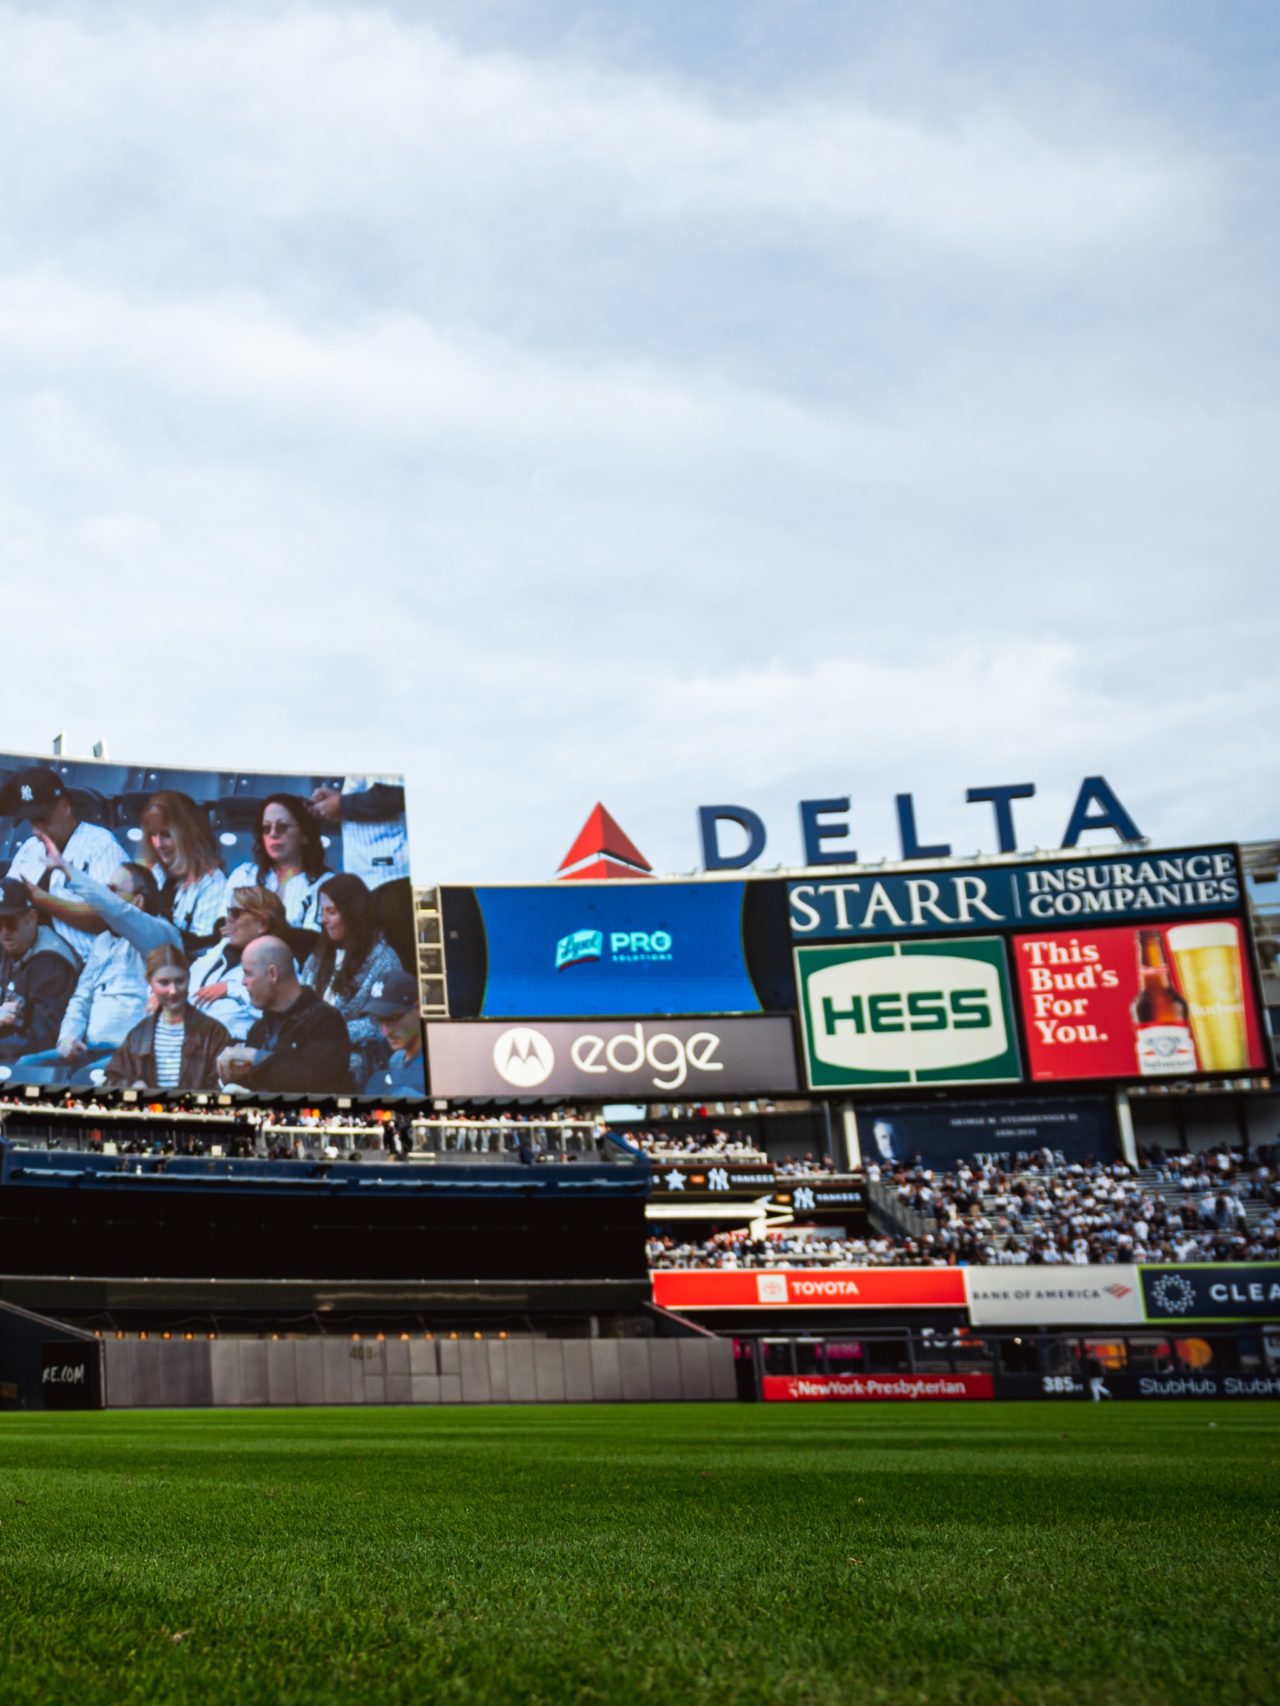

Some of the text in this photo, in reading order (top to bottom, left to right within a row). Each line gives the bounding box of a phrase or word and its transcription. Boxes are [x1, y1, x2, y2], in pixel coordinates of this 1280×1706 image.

[698, 775, 1145, 871] DELTA
[1026, 853, 1237, 893] INSURANCE
[790, 875, 1006, 932] STARR
[1028, 876, 1240, 918] COMPANIES
[610, 930, 672, 953] PRO
[1024, 938, 1100, 966] This
[1029, 963, 1119, 993] Bud's
[823, 988, 992, 1036] HESS
[1033, 994, 1088, 1019] For
[1035, 1020, 1109, 1045] You.
[571, 1022, 724, 1090] edge
[731, 1174, 776, 1184] YANKEES
[791, 1281, 859, 1295] TOYOTA
[972, 1288, 1101, 1300] BANK OF AMERICA
[1042, 1376, 1073, 1392] 385
[1139, 1376, 1217, 1394] StubHub
